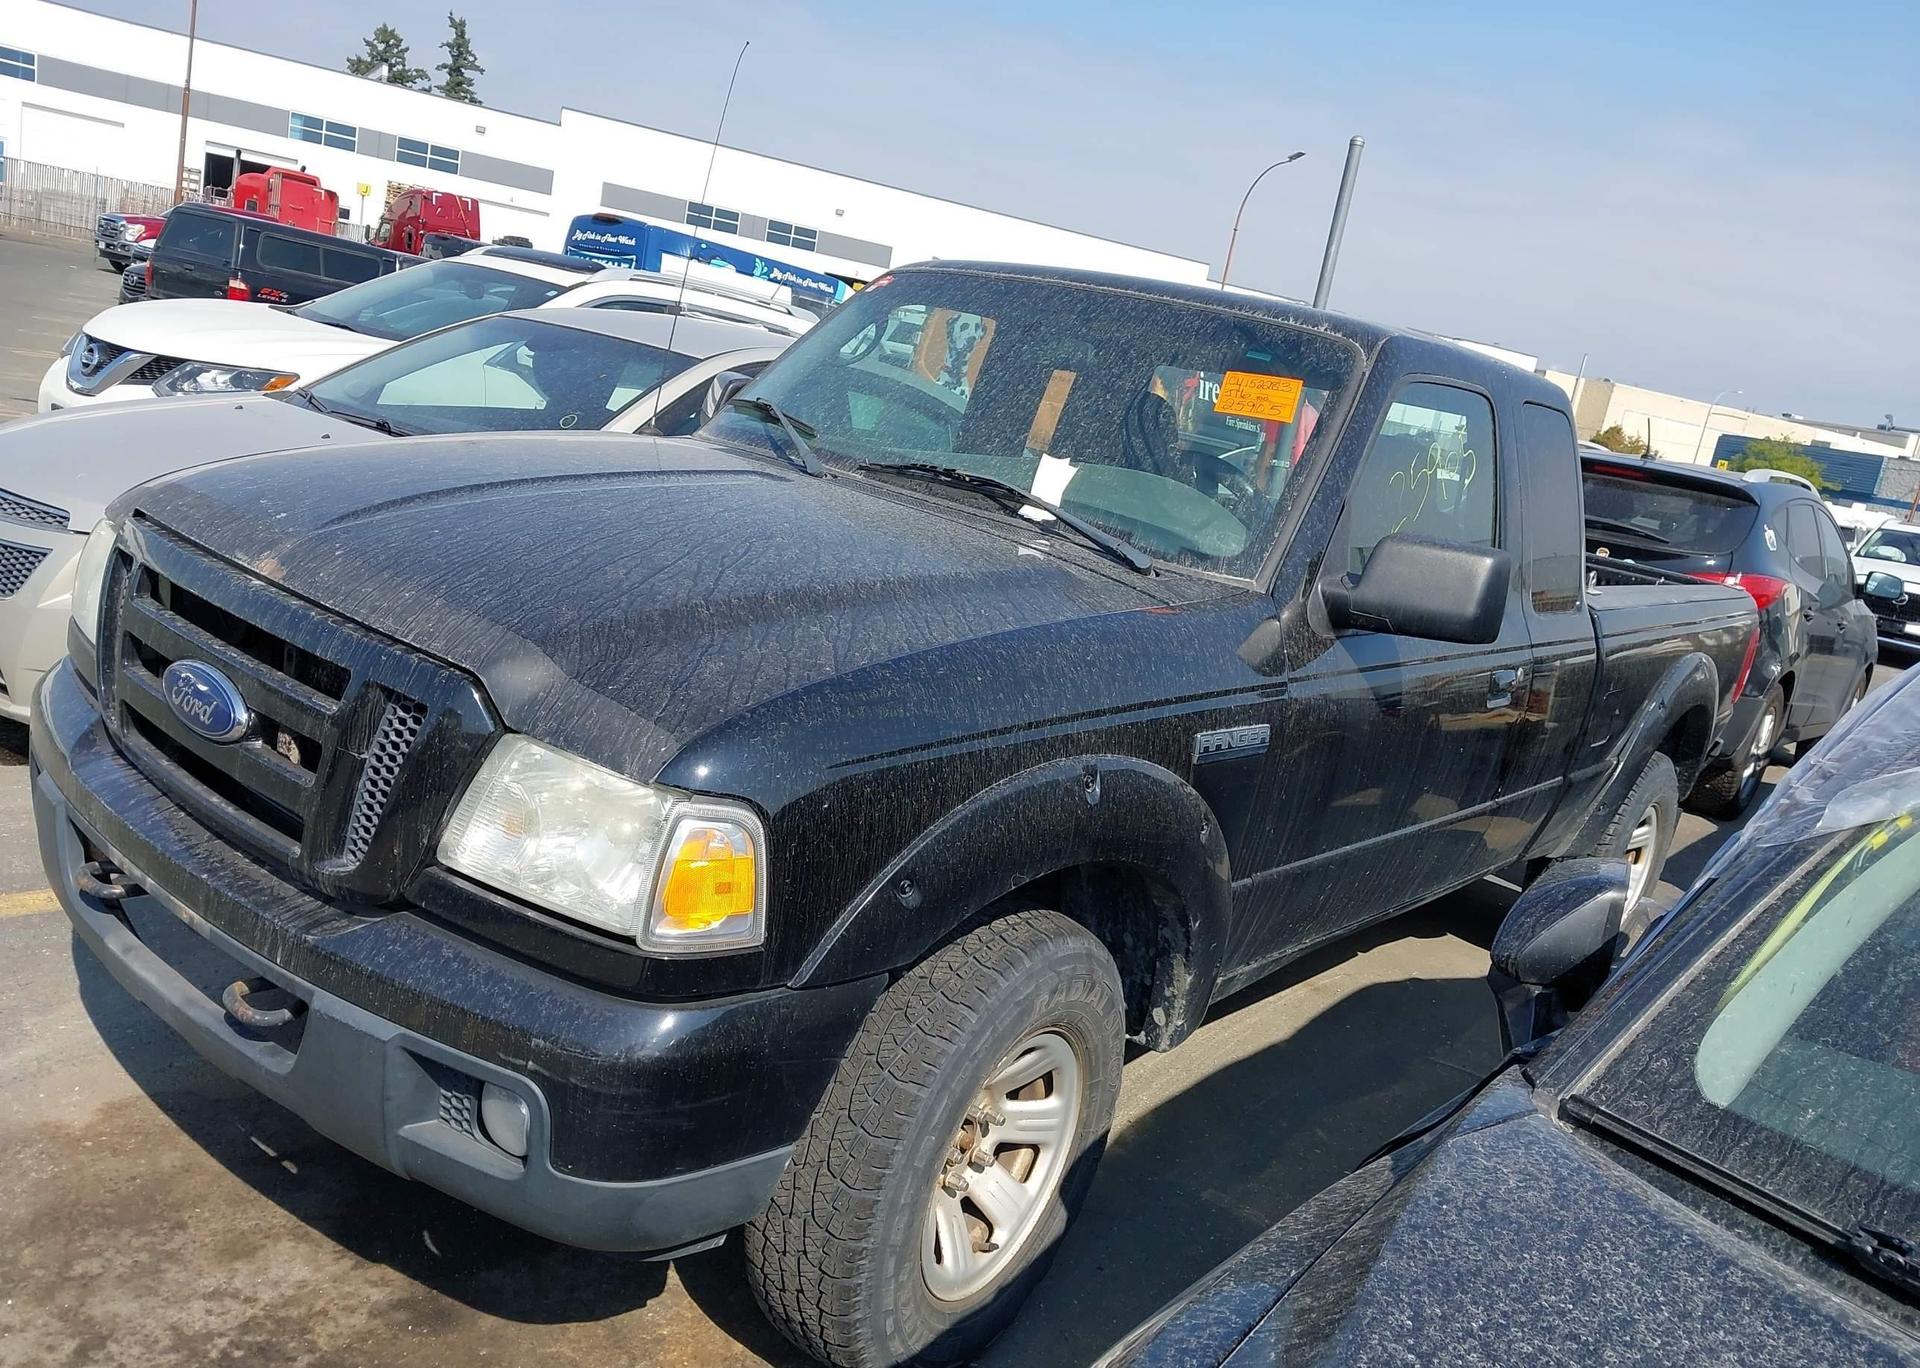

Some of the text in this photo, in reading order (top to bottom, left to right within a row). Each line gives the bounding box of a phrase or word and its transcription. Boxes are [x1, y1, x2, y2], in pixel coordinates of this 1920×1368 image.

[618, 235, 636, 246] Wash
[819, 281, 834, 294] Wash
[172, 672, 217, 725] Ford
[1198, 725, 1270, 752] RANGER
[1030, 978, 1109, 1019] RADIAL
